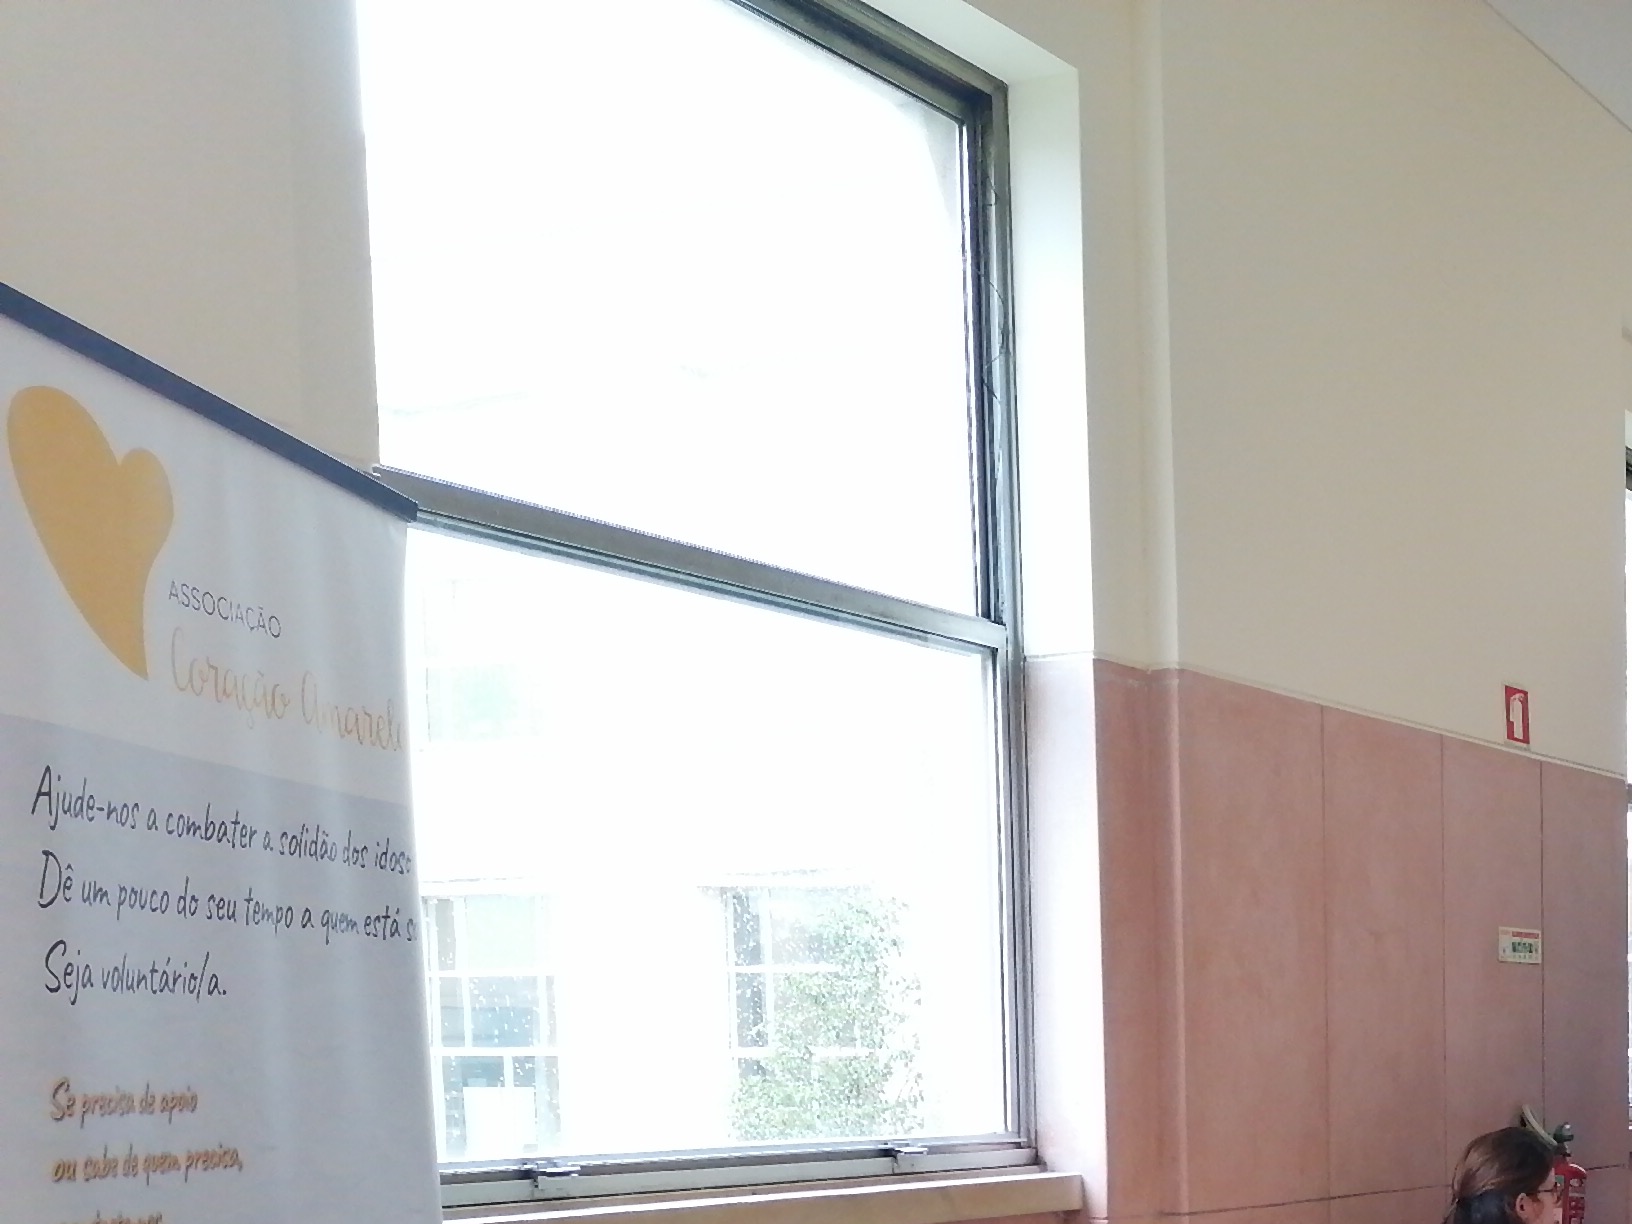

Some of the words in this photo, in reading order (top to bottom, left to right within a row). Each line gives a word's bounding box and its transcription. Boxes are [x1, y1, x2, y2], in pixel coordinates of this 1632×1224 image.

[168, 580, 282, 638] ASSOCIAÇÃO
[171, 627, 290, 730] Coração
[31, 765, 139, 831] Ajude-nos
[147, 812, 158, 831] a
[166, 802, 257, 849] combater
[263, 831, 274, 852] a
[279, 823, 337, 862] solidão
[342, 829, 368, 868] dos
[38, 849, 73, 908] Dê
[82, 879, 111, 906] um
[117, 882, 169, 920] pouco
[177, 876, 199, 917] do
[206, 896, 237, 922] seu
[244, 886, 294, 936] tempo
[301, 907, 315, 929] a
[320, 909, 360, 944] quem
[364, 905, 401, 940] está
[44, 939, 94, 1005] Seja
[101, 951, 227, 1001] voluntário/a.
[50, 1077, 75, 1122] Se
[81, 1085, 135, 1128] precisa
[139, 1082, 155, 1115] de
[160, 1086, 198, 1124] apoio
[52, 1157, 76, 1183] ou
[83, 1145, 118, 1181] sabe
[122, 1142, 139, 1177] de
[143, 1152, 181, 1186] quem
